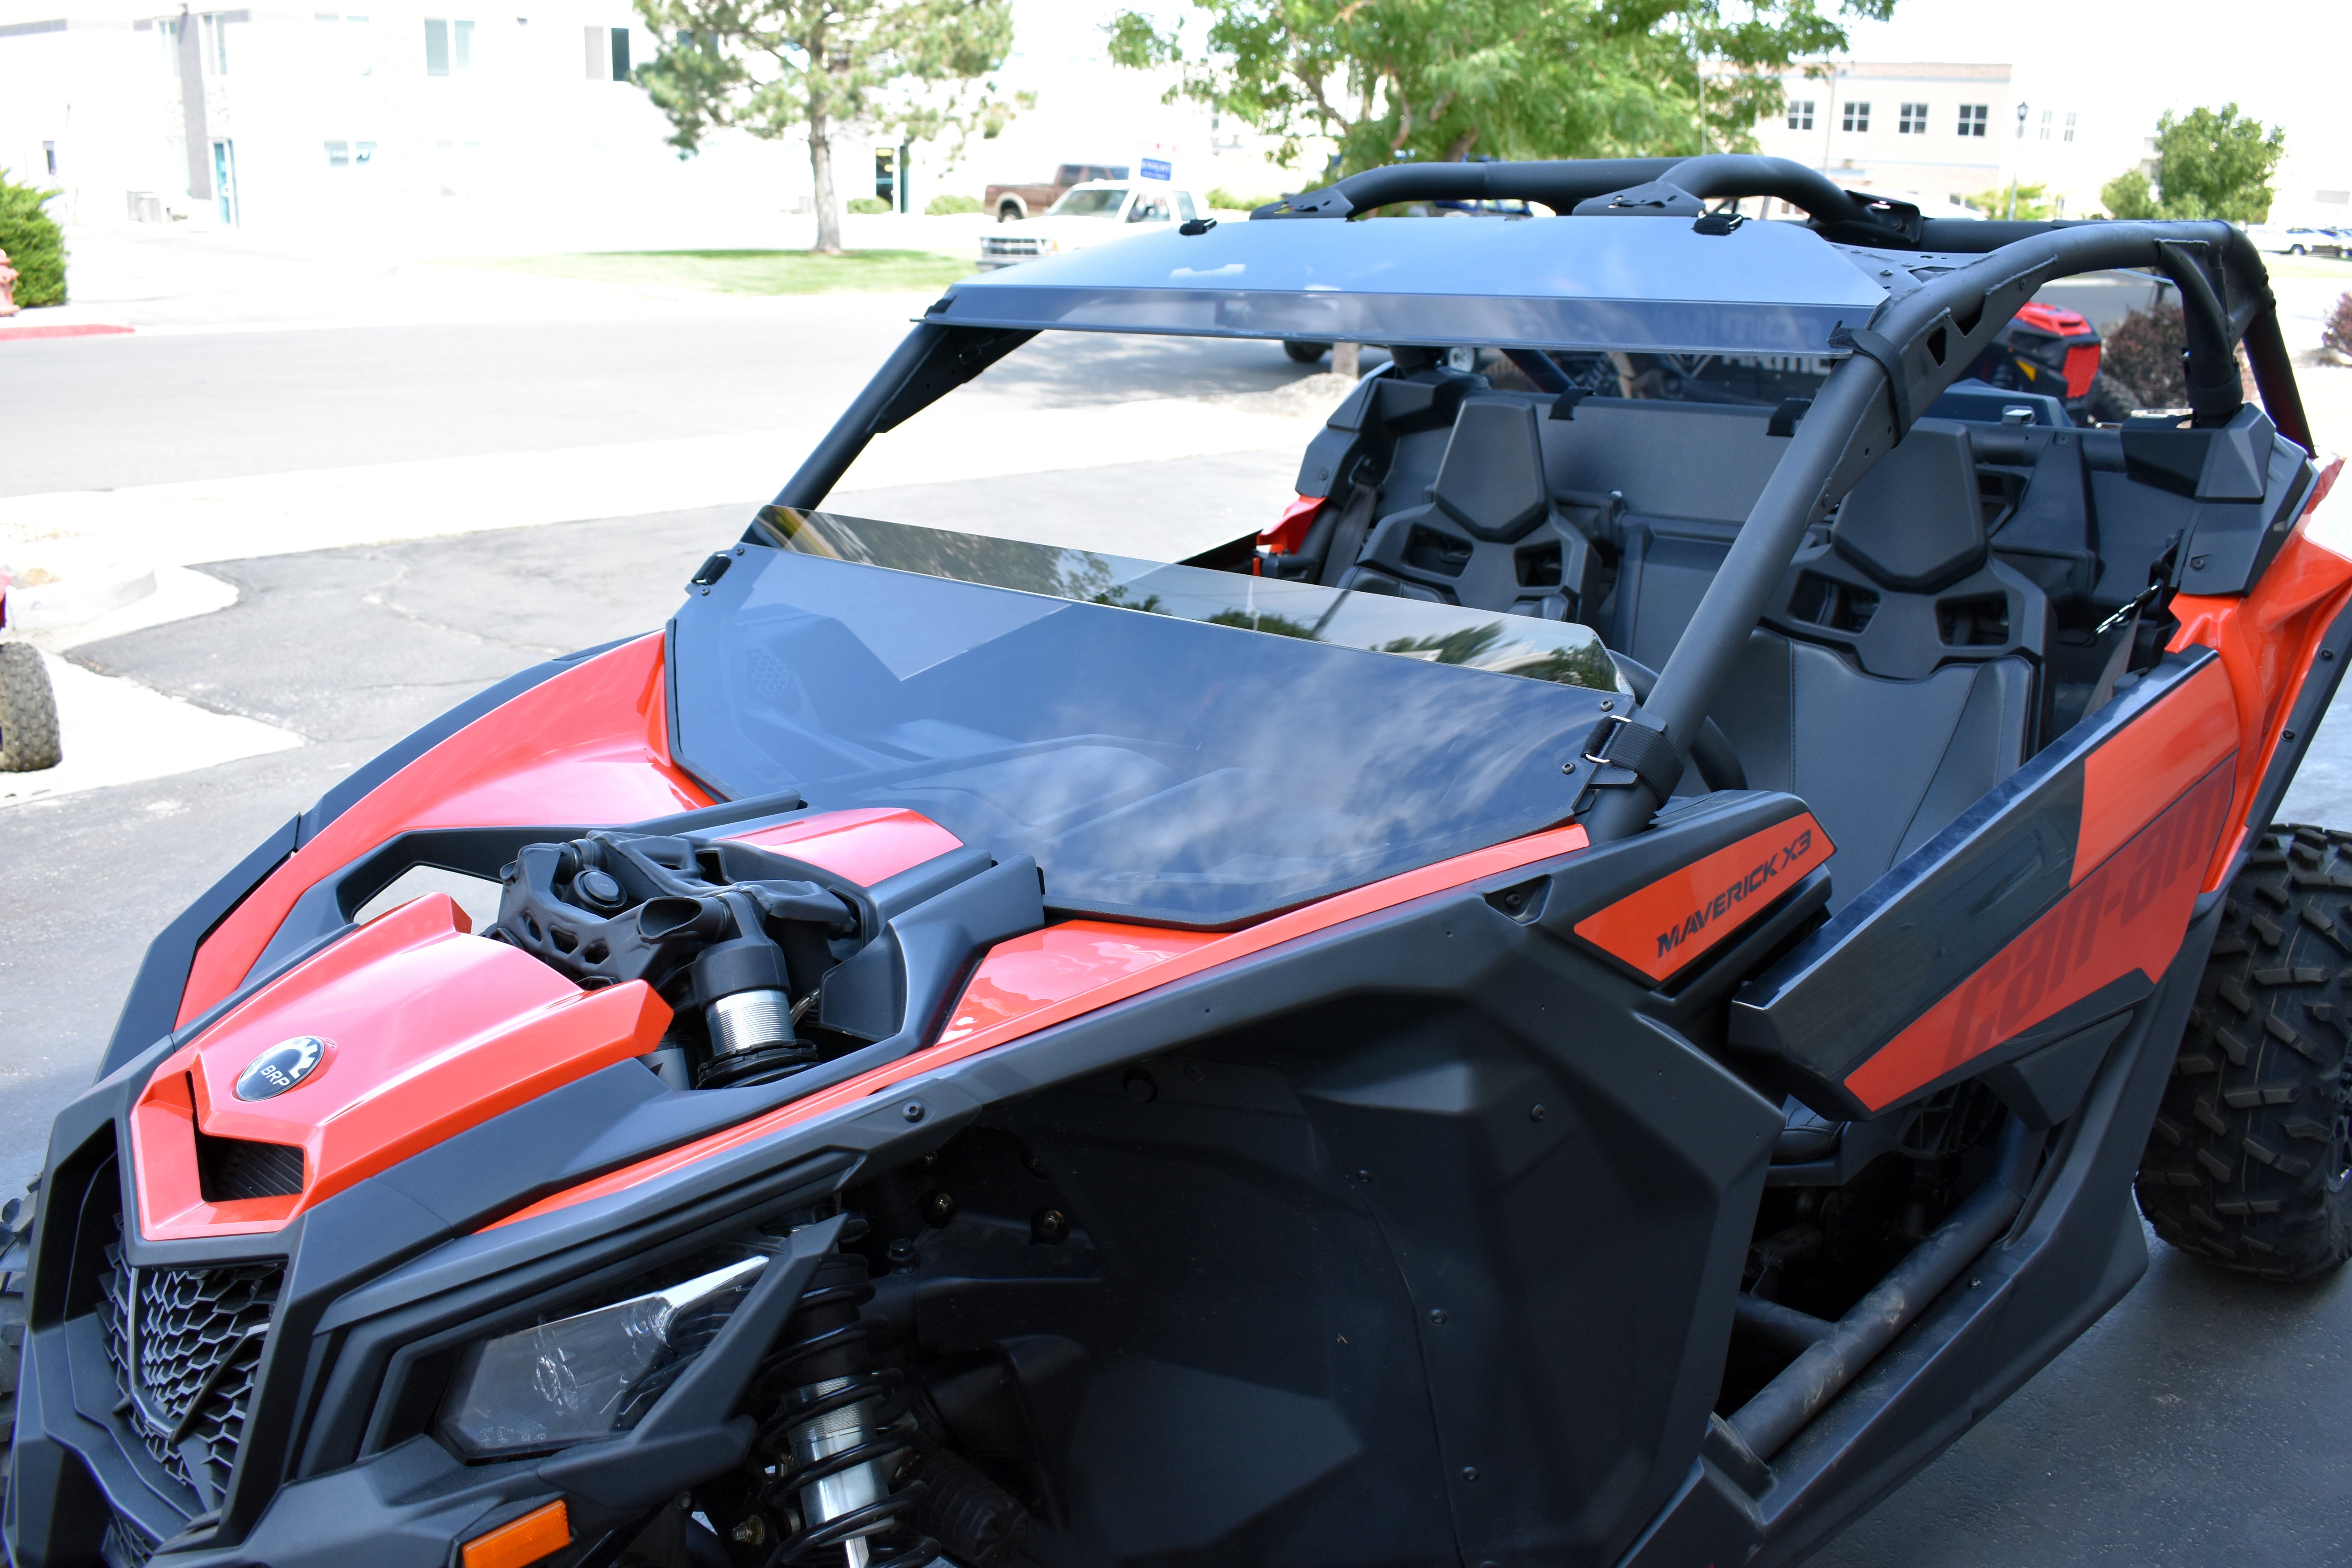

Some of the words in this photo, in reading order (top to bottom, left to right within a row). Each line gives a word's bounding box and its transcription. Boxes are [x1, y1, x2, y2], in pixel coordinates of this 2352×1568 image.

[1657, 853, 1778, 958] MAVERICK
[1781, 829, 1811, 869] X3
[260, 1064, 290, 1086] BRP
